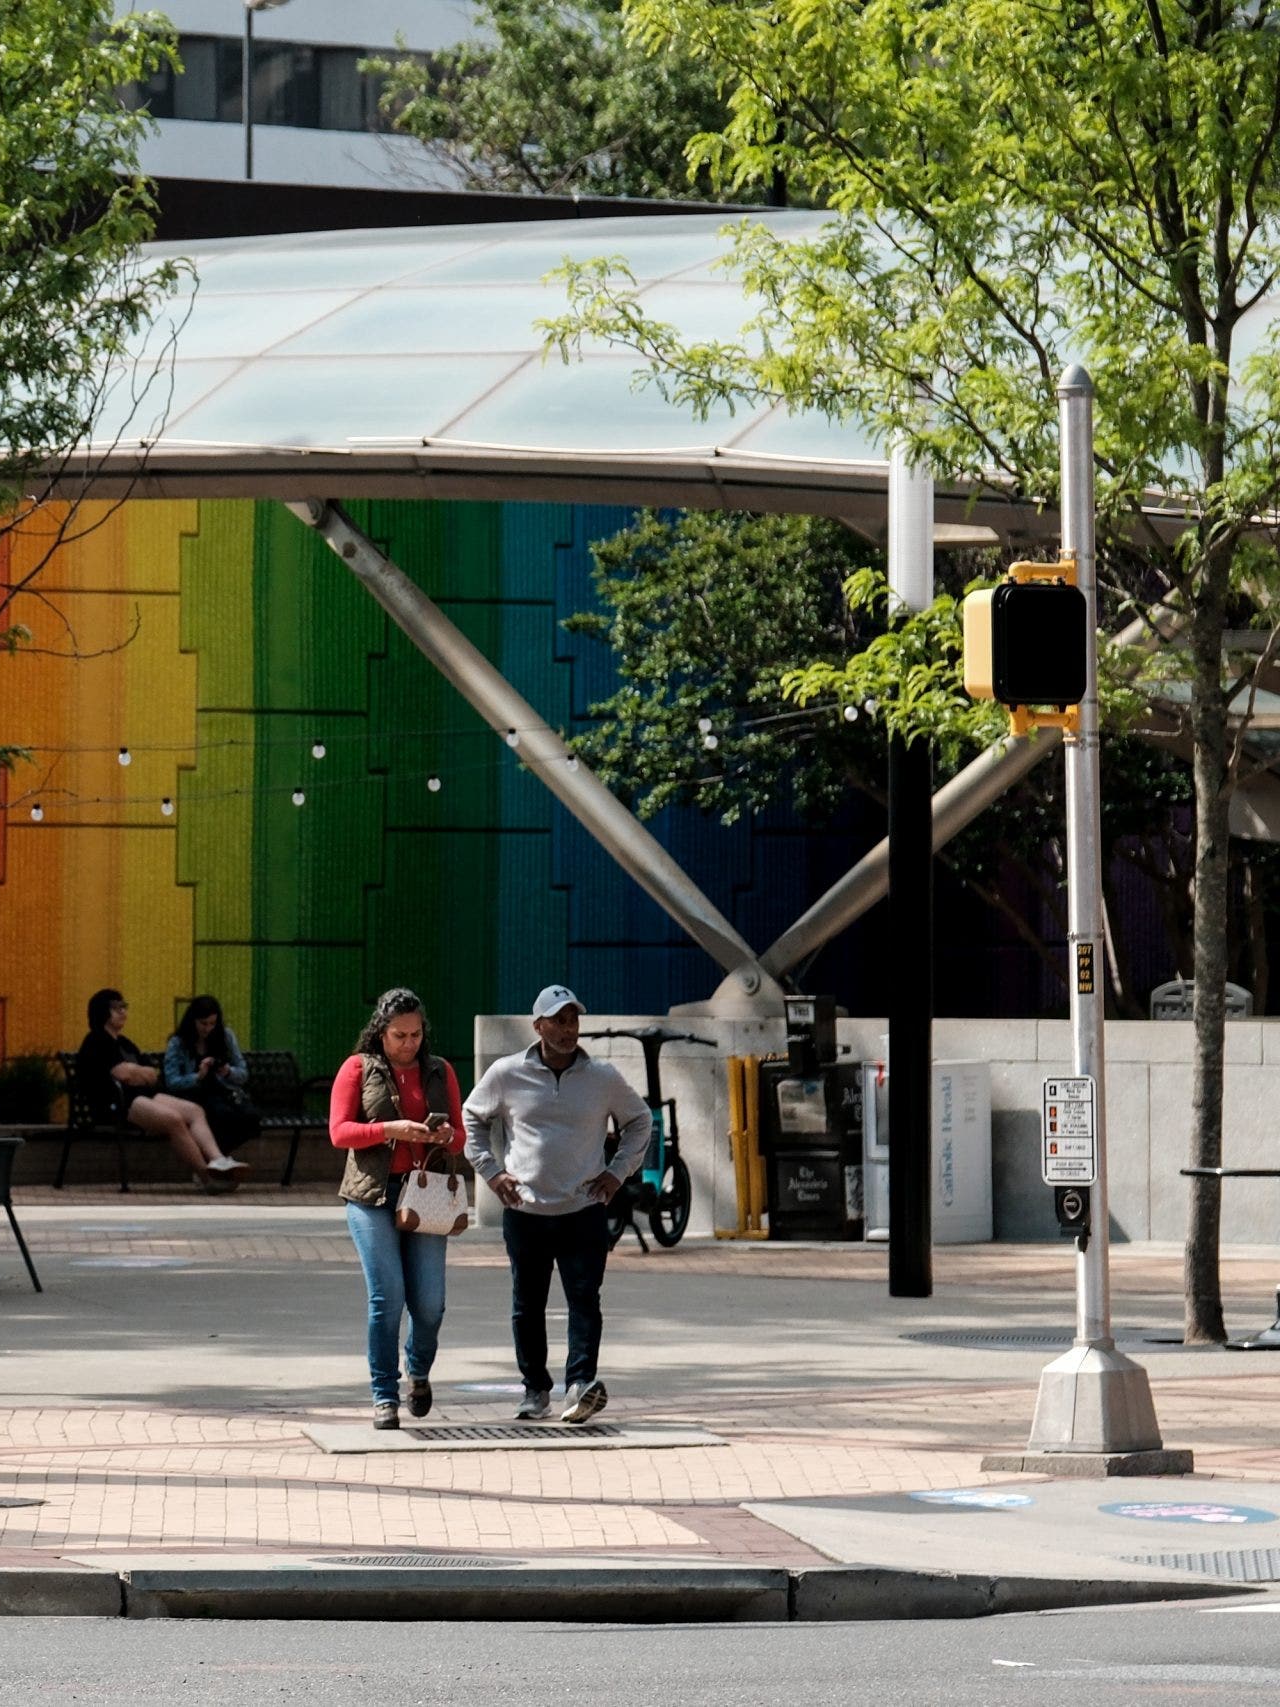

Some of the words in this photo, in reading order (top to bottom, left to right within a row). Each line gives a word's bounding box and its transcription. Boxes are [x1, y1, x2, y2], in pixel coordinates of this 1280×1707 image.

[1078, 946, 1092, 955] 207
[1079, 958, 1090, 967] PP
[1080, 970, 1090, 980] 02
[1078, 982, 1093, 992] NW
